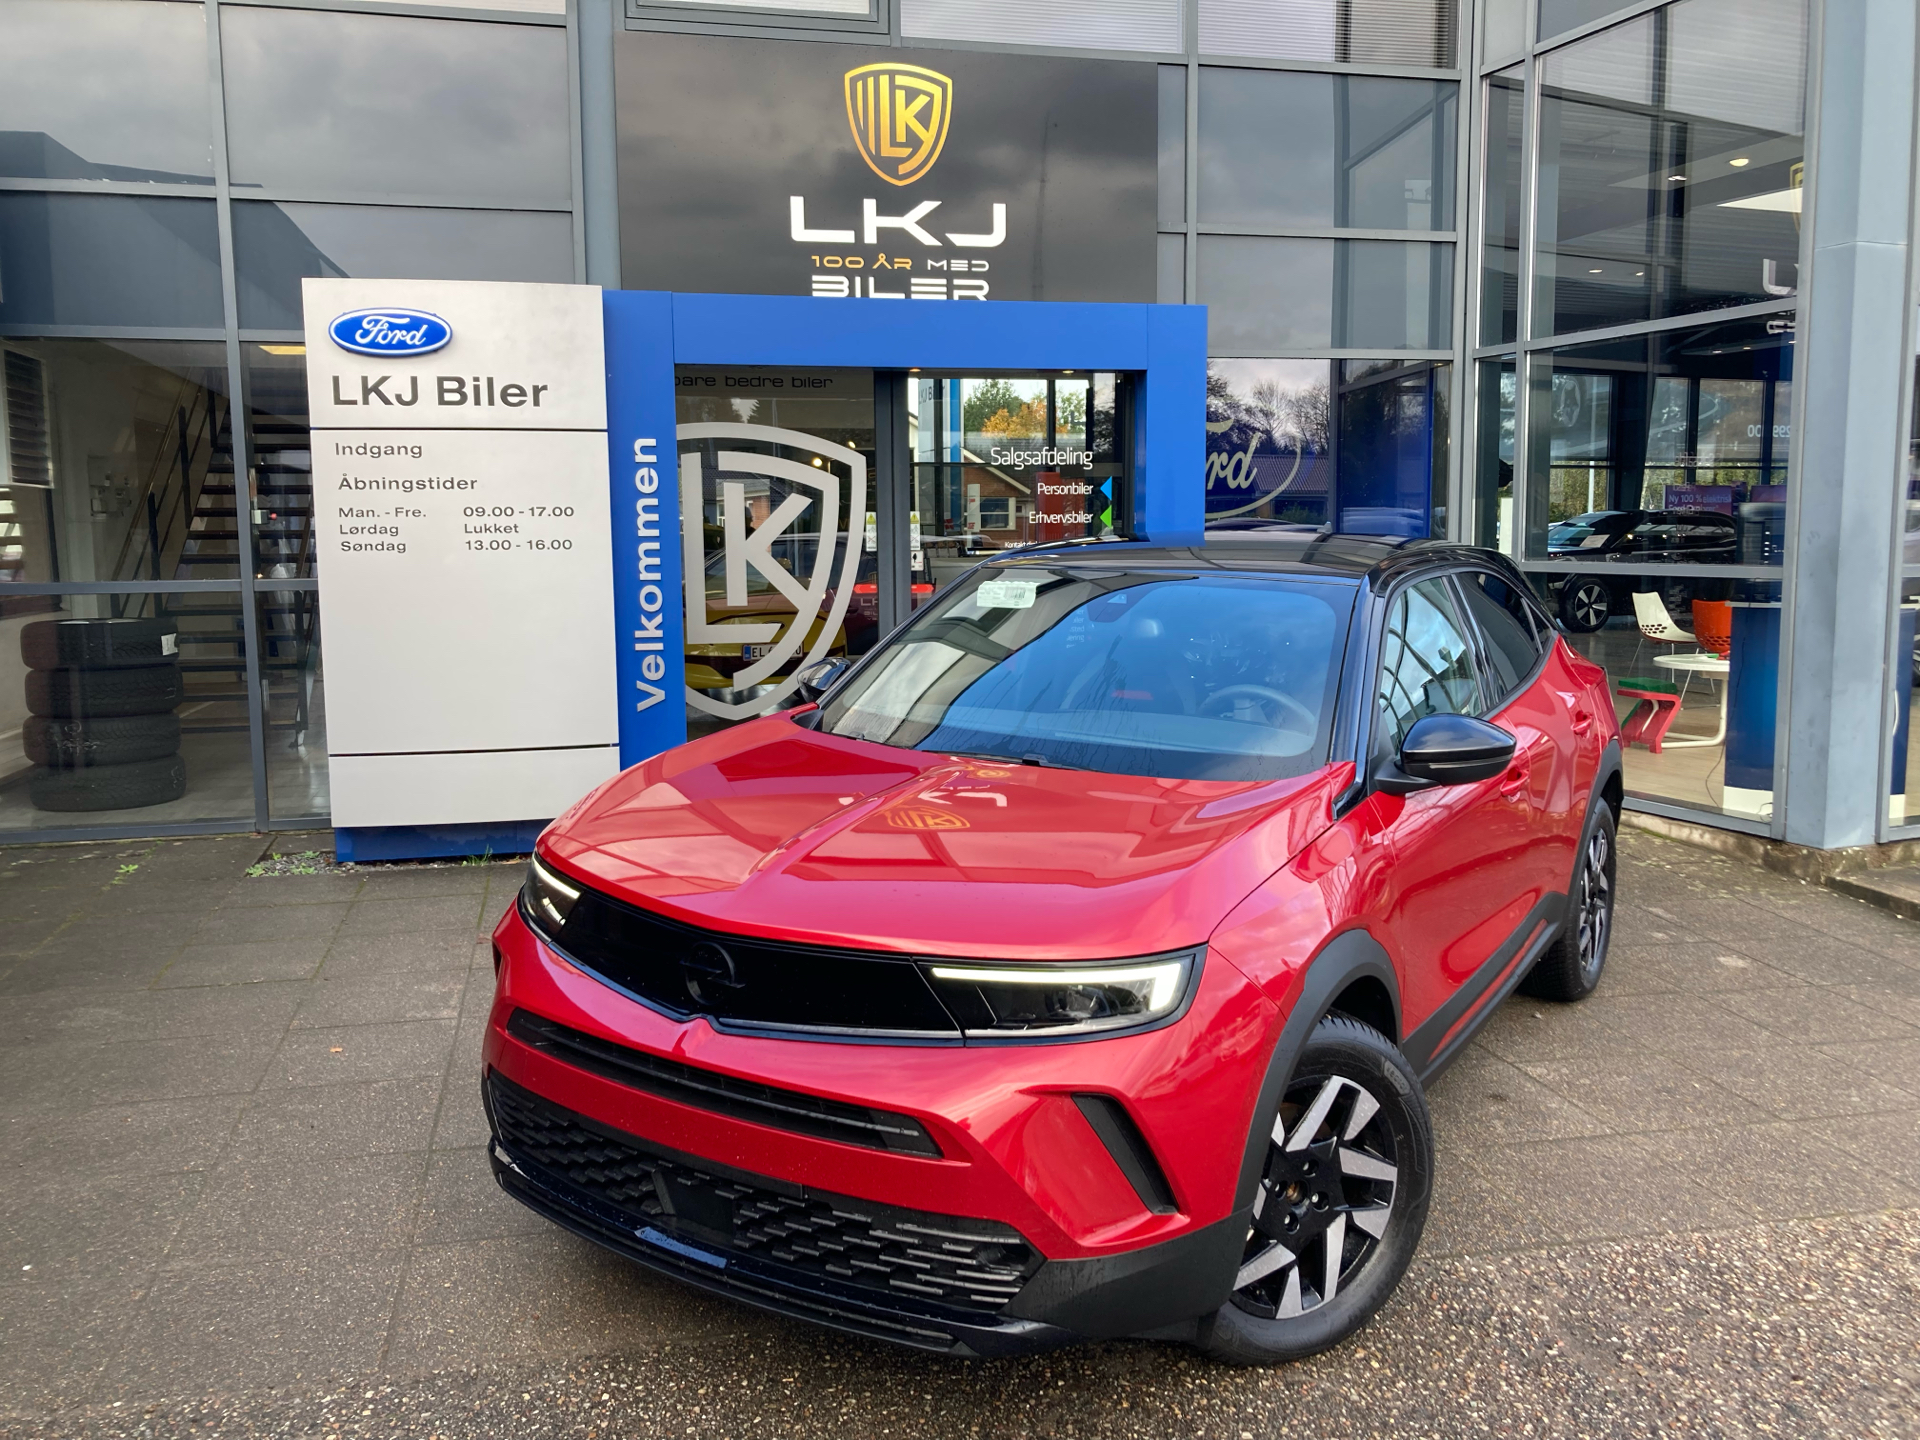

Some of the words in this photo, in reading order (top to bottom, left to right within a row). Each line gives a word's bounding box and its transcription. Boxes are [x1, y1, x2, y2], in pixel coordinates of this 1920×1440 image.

[789, 195, 1007, 248] LKJ
[811, 255, 865, 269] 100
[872, 253, 913, 270] ÅR
[927, 259, 990, 272] MED
[811, 275, 990, 301] BILER
[354, 315, 428, 346] Ford
[725, 375, 784, 388] bedre
[791, 376, 833, 389] biler
[331, 375, 419, 407] LKJ
[436, 375, 549, 408] Biler
[335, 442, 423, 459] Indgang
[990, 446, 1094, 470] Salgsafdeling
[338, 473, 478, 493] Åbningstider
[1037, 482, 1094, 495] Personbiler
[1681, 494, 1694, 503] 100
[338, 507, 381, 518] Man.
[394, 507, 427, 518] Fre.
[463, 506, 515, 518] 09.00
[528, 506, 575, 518] 17.00
[1029, 511, 1094, 524] Erhvervsbiler
[339, 523, 400, 537] Lørdag
[464, 522, 520, 534] Lukket
[340, 540, 407, 554] Søndag
[465, 540, 512, 552] 13.00
[526, 539, 573, 551] 16.00
[634, 438, 666, 713] Velkommen
